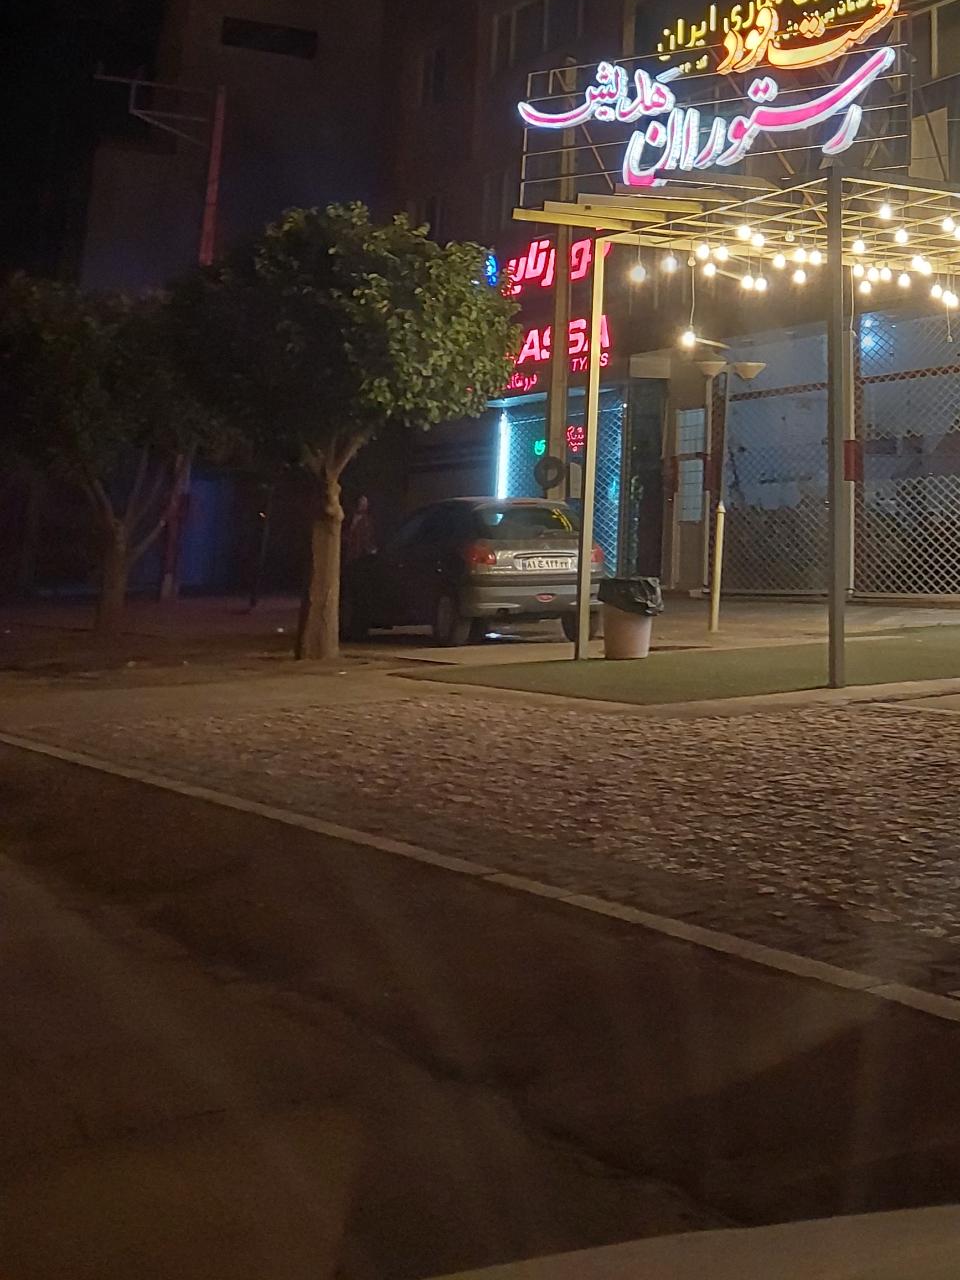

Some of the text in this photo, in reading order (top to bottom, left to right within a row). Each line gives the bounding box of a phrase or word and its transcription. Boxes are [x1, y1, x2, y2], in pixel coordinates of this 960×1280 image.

[656, 4, 717, 62] ایران
[622, 46, 897, 188] رستوران
[571, 352, 609, 372] TYS
